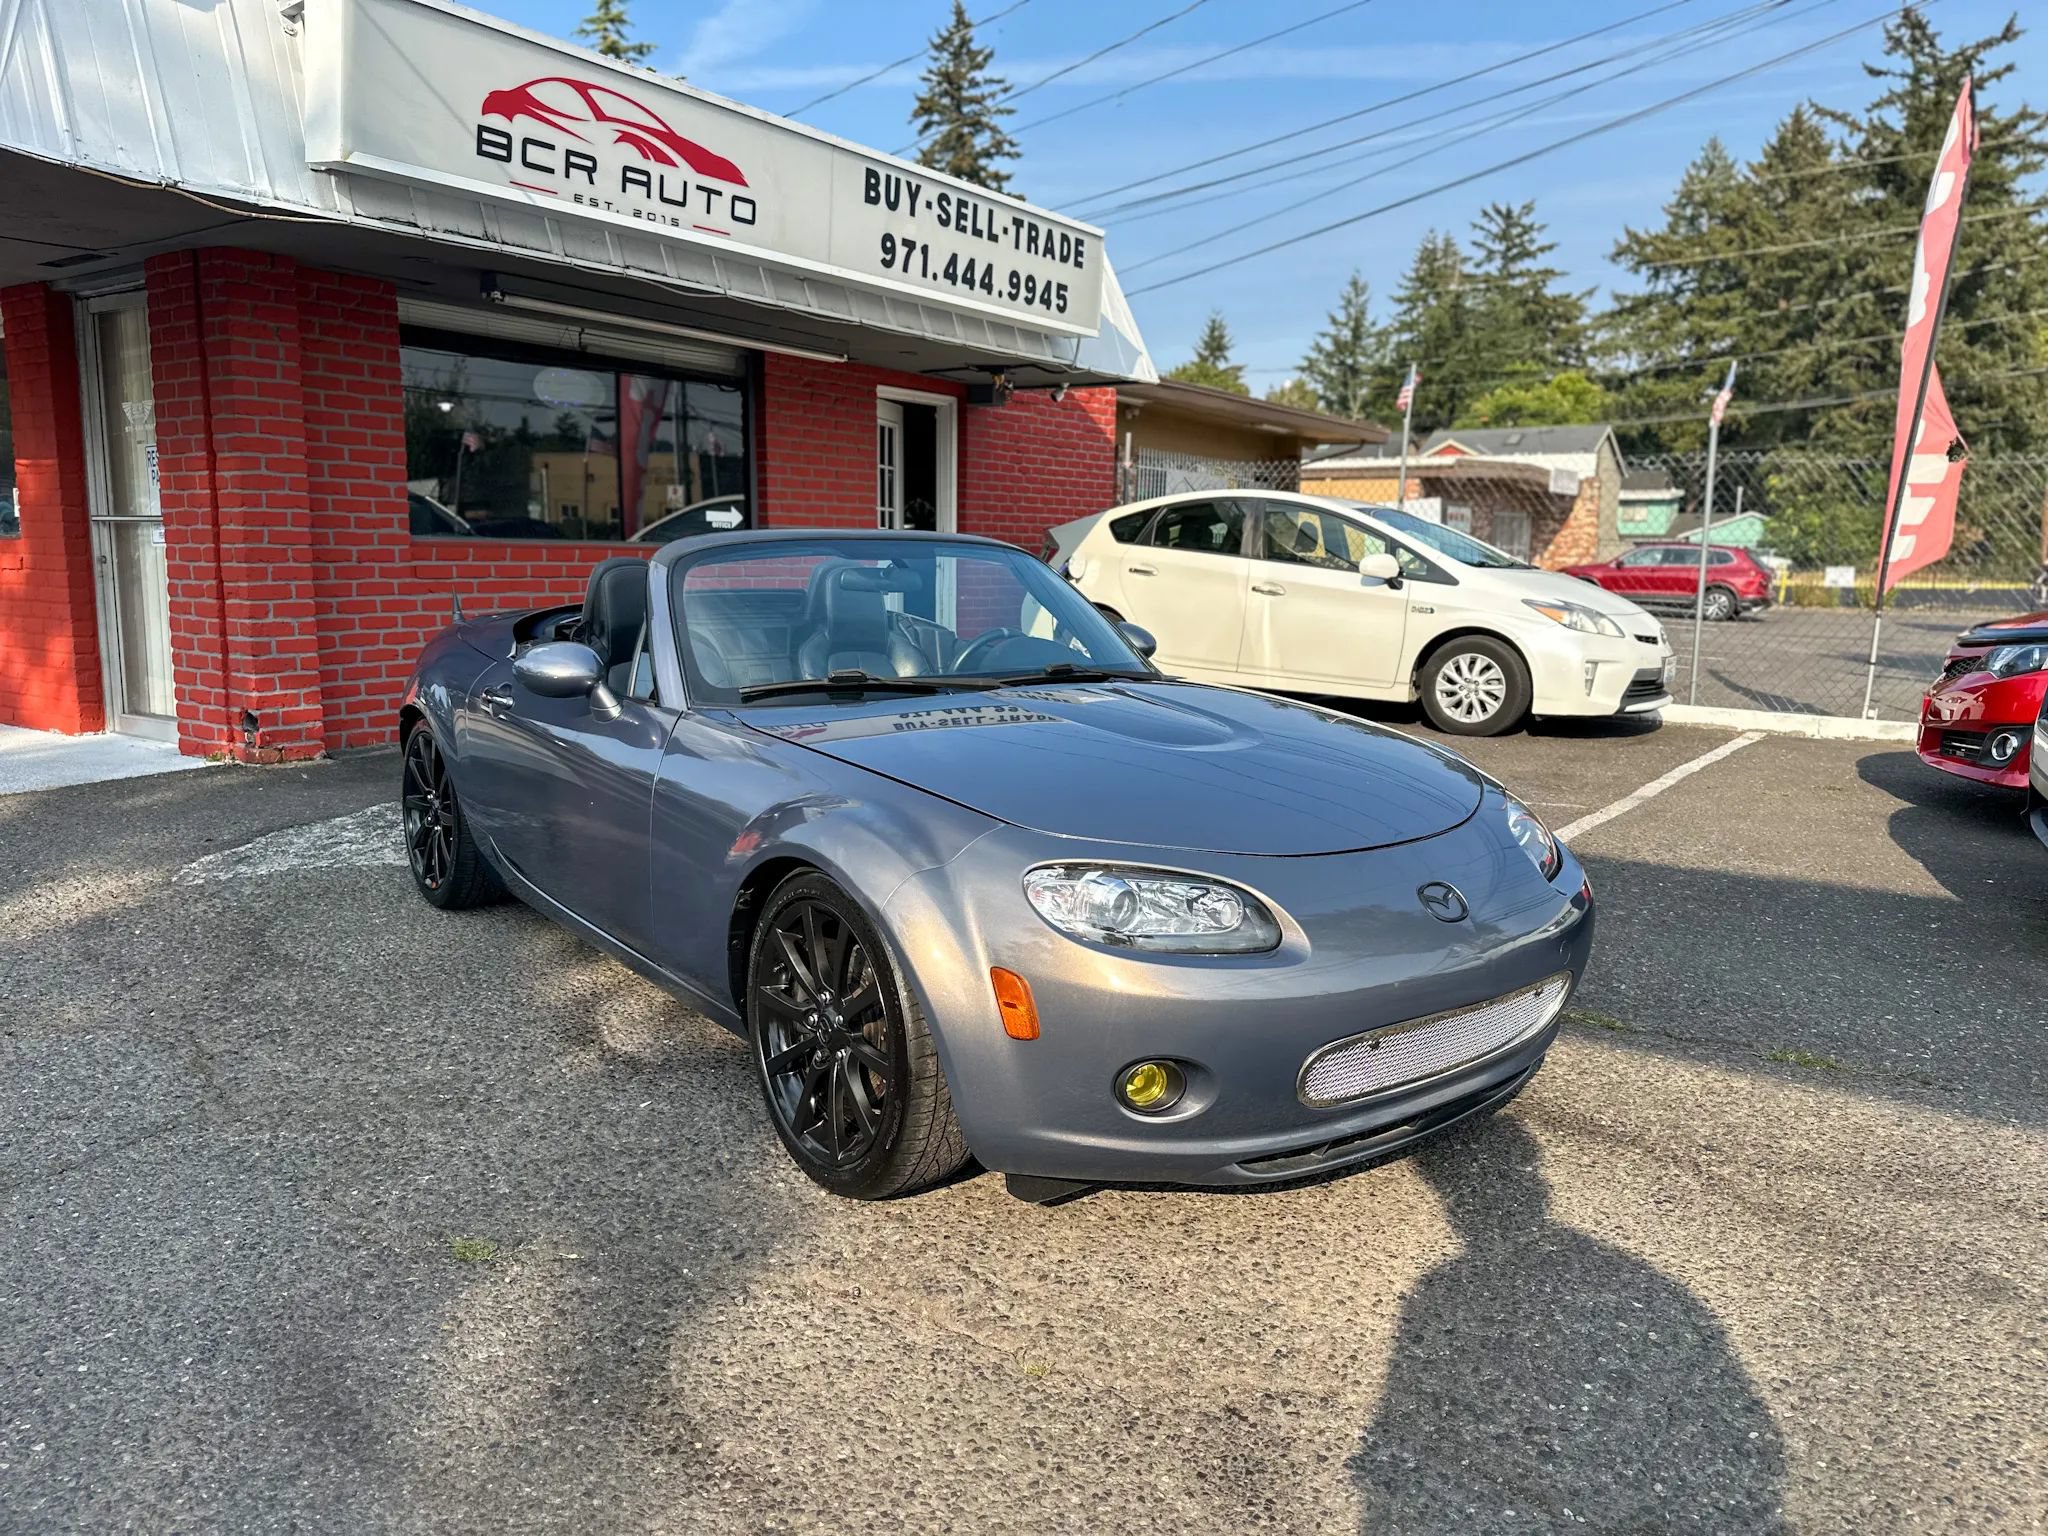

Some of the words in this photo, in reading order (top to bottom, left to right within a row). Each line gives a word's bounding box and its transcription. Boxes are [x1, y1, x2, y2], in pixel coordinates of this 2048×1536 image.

[476, 123, 598, 185] BCR
[621, 165, 756, 226] AUTO
[574, 193, 620, 213] EST.
[633, 208, 680, 227] 2015
[864, 166, 1085, 270] BUY-SELL-TRADE
[880, 232, 1069, 314] 971.444.9945
